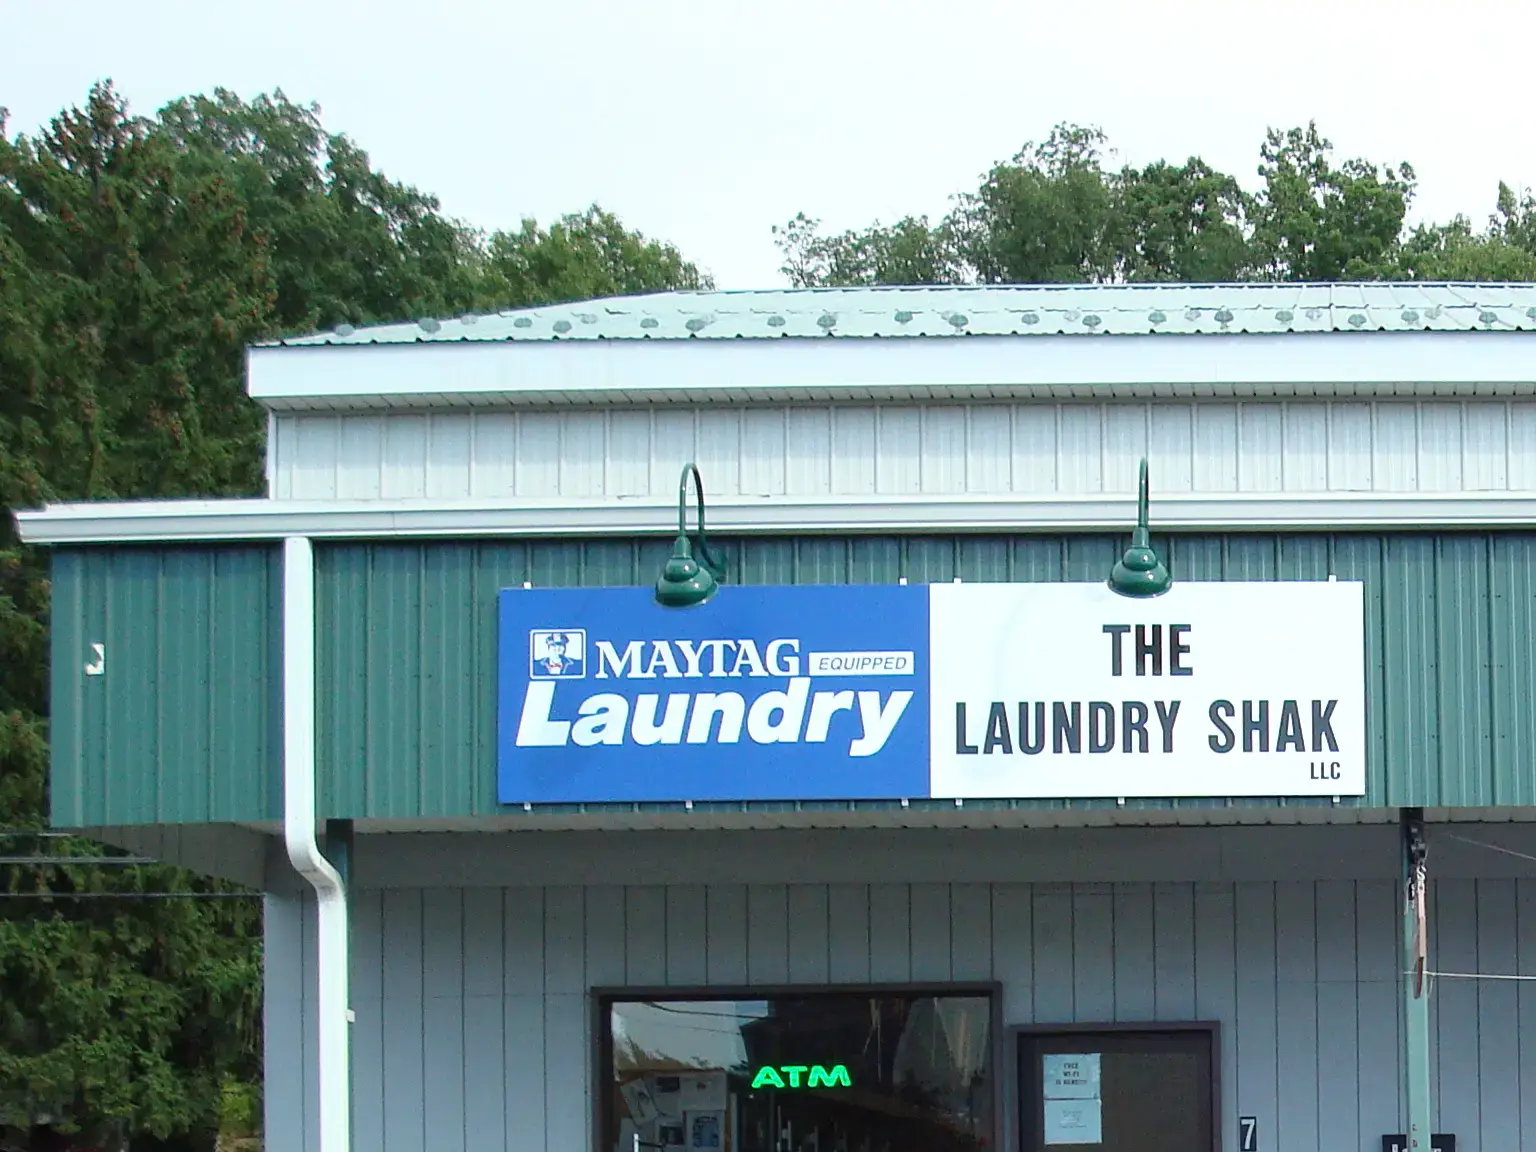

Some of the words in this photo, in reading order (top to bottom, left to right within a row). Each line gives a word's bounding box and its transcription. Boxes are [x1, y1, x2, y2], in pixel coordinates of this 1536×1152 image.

[595, 639, 800, 679] MAYTAG
[818, 655, 908, 671] EQUIPPED
[1102, 623, 1193, 677] THE
[515, 676, 914, 757] Laundry
[956, 700, 1181, 755] LAUNDRY
[1208, 699, 1340, 754] SHAK
[1310, 761, 1341, 780] LLC
[751, 1064, 852, 1089] ATM
[1241, 1118, 1256, 1150] 7
